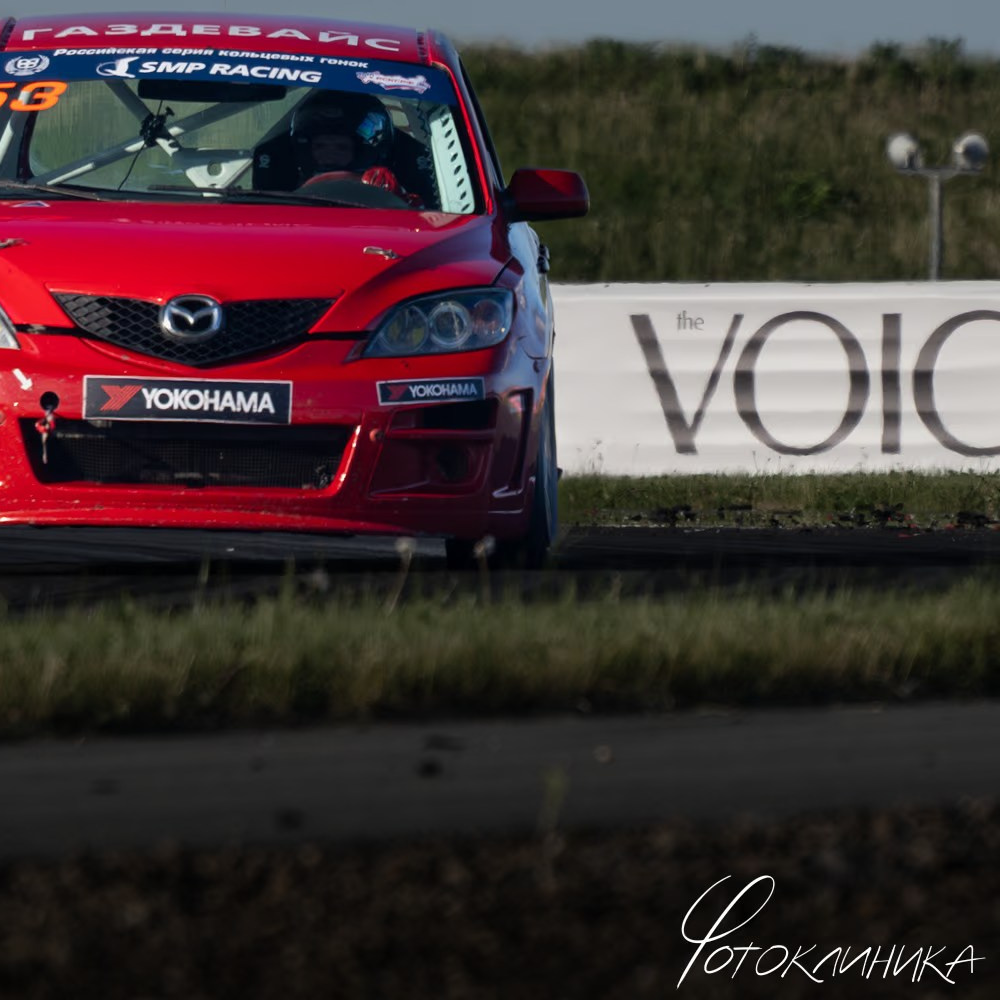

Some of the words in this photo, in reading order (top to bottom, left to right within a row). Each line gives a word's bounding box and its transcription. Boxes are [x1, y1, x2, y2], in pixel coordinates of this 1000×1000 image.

[22, 23, 401, 52] ГАЗДЕВАЙС
[53, 47, 157, 57] Российская
[161, 47, 214, 57] серия
[218, 50, 315, 63] кольцевых
[320, 57, 369, 69] гонок
[138, 61, 207, 76] SMP
[209, 63, 323, 83] RACING
[676, 310, 705, 331] the
[141, 387, 276, 414] YOKOHAMA
[408, 382, 478, 398] YOKOHAMA
